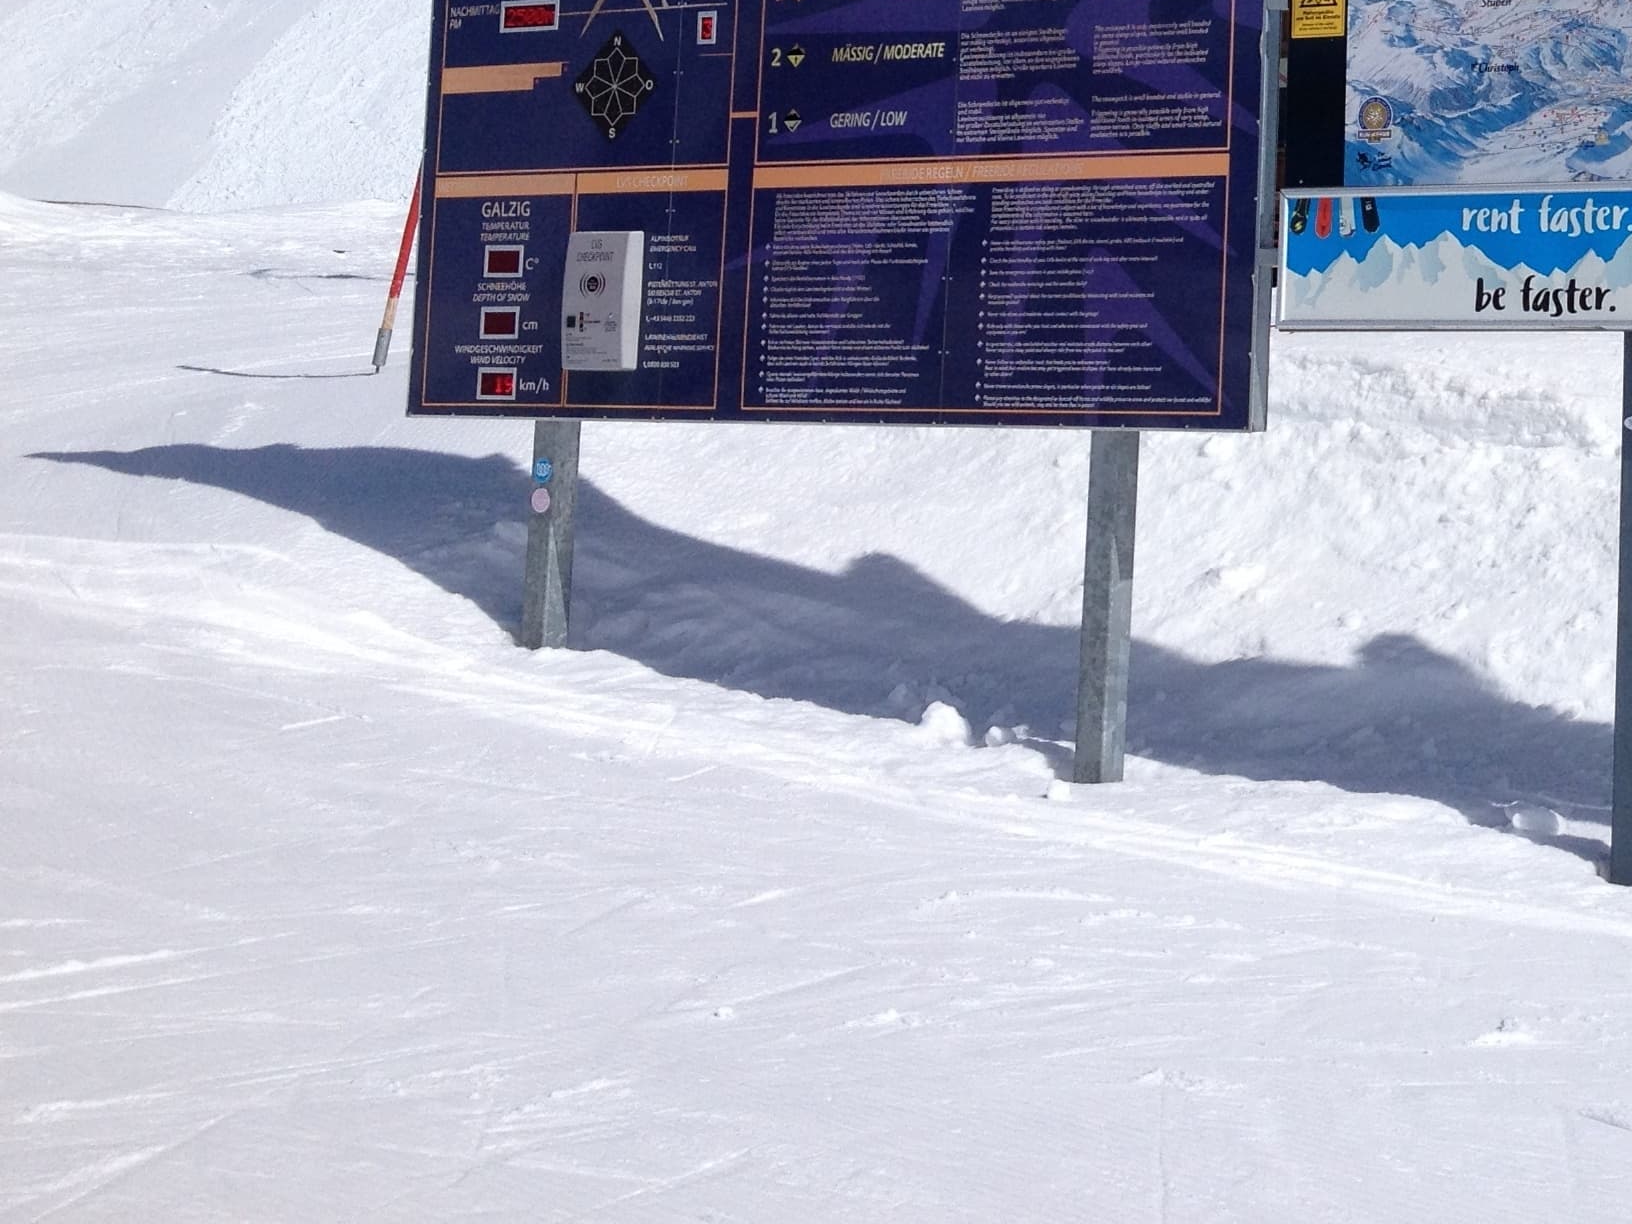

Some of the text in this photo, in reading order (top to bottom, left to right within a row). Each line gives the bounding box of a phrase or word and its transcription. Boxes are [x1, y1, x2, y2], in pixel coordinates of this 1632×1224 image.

[771, 42, 946, 67] 2 MÄSSIG MODERATE
[768, 110, 907, 134] 1 GERING LOW
[482, 201, 531, 218] GALZIG
[1462, 199, 1525, 234] rent
[1475, 274, 1616, 317] be faster.
[522, 321, 538, 330] cm
[519, 378, 549, 394] km/h
